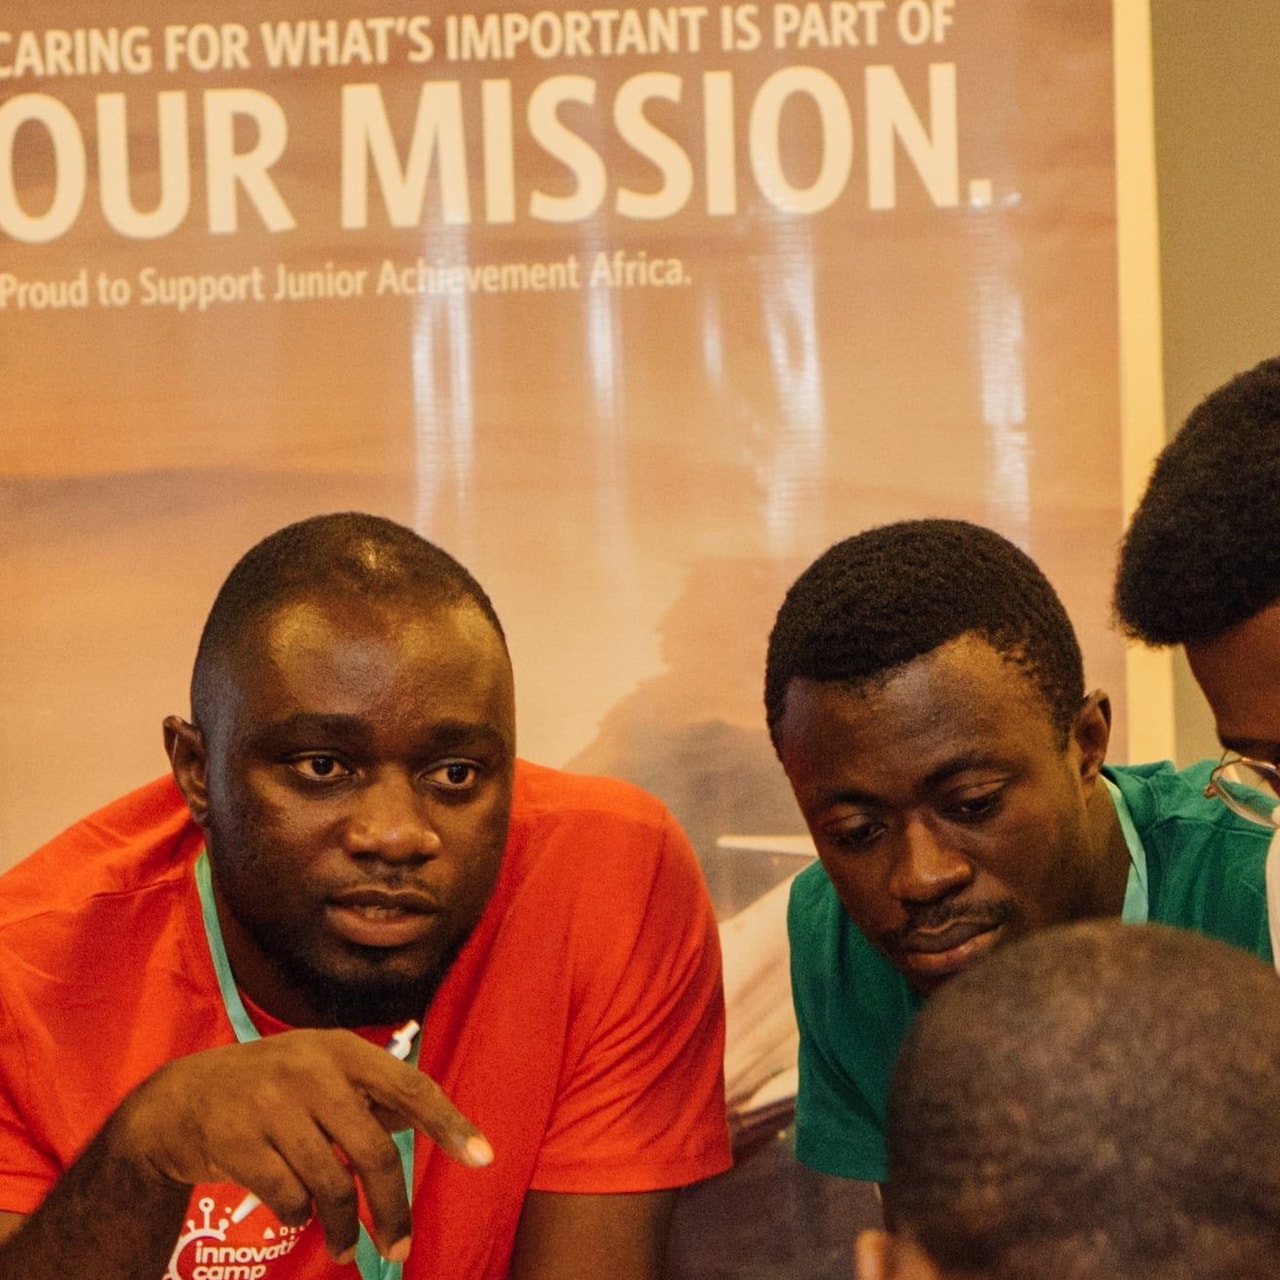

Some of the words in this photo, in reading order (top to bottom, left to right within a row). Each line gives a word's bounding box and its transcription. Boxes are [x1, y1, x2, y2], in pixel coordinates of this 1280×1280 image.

[164, 23, 251, 71] FOR
[260, 16, 434, 69] WHAT'S
[446, 8, 708, 61] IMPORTANT
[721, 4, 761, 50] IS
[773, 1, 885, 48] PART
[897, 0, 956, 45] OF
[340, 62, 993, 229] MISSION.
[98, 272, 132, 307] to
[139, 266, 263, 312] Support
[273, 261, 367, 299] Junior
[376, 251, 580, 297] Achievement
[589, 249, 692, 289] Africa.
